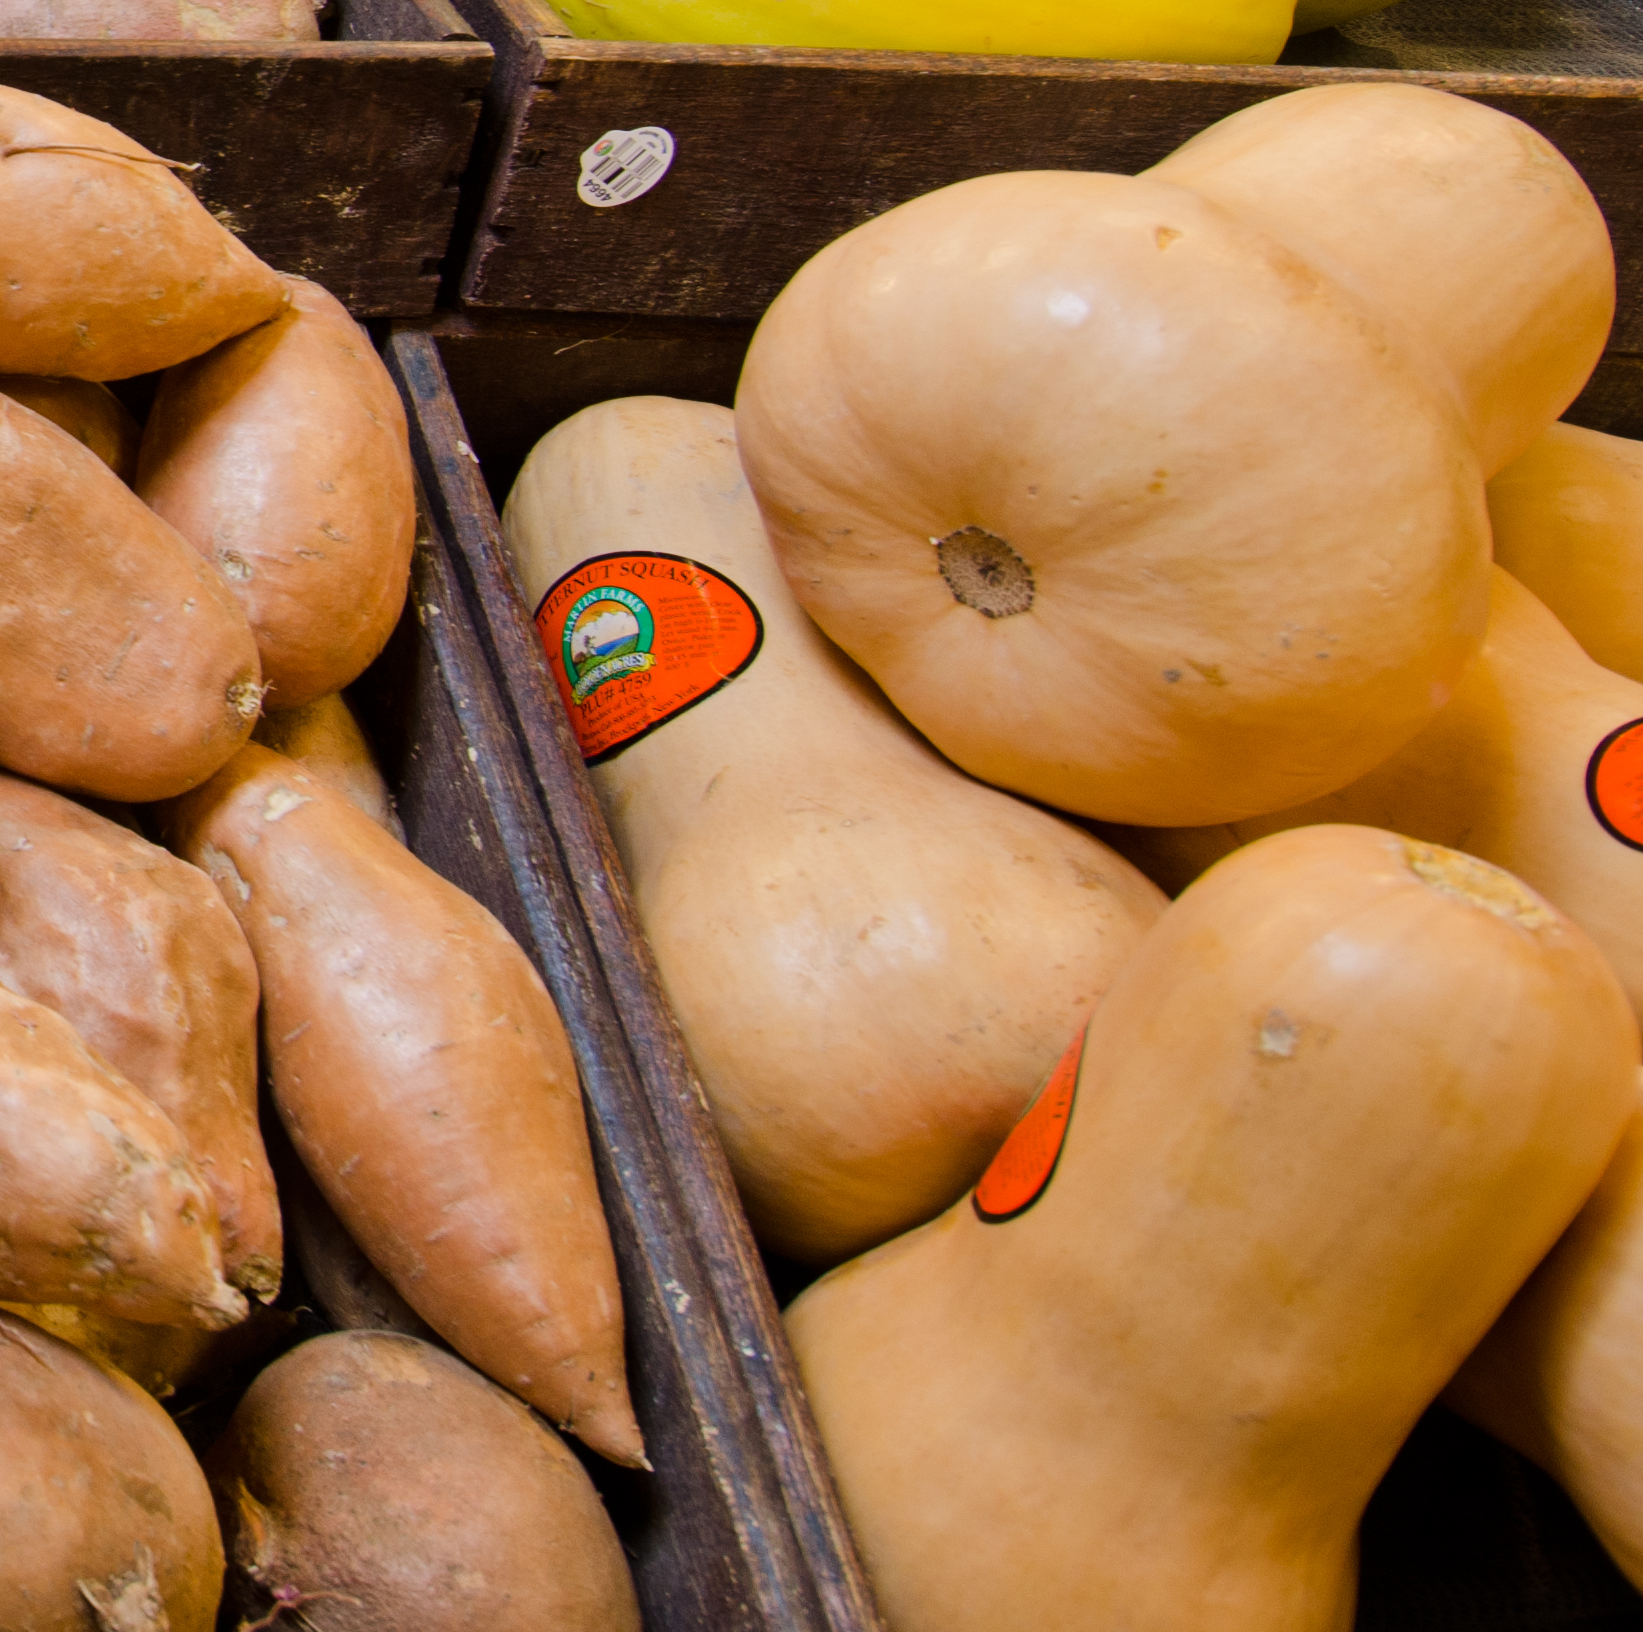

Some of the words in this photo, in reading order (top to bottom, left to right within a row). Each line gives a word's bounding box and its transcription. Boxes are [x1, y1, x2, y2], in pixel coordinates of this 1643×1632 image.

[538, 563, 614, 627] TTERNUT
[618, 561, 710, 590] SQUASH
[563, 590, 598, 642] MARTIN
[600, 588, 646, 613] FARMS
[618, 672, 652, 694] 4759
[652, 701, 674, 713] New
[676, 684, 699, 700] York
